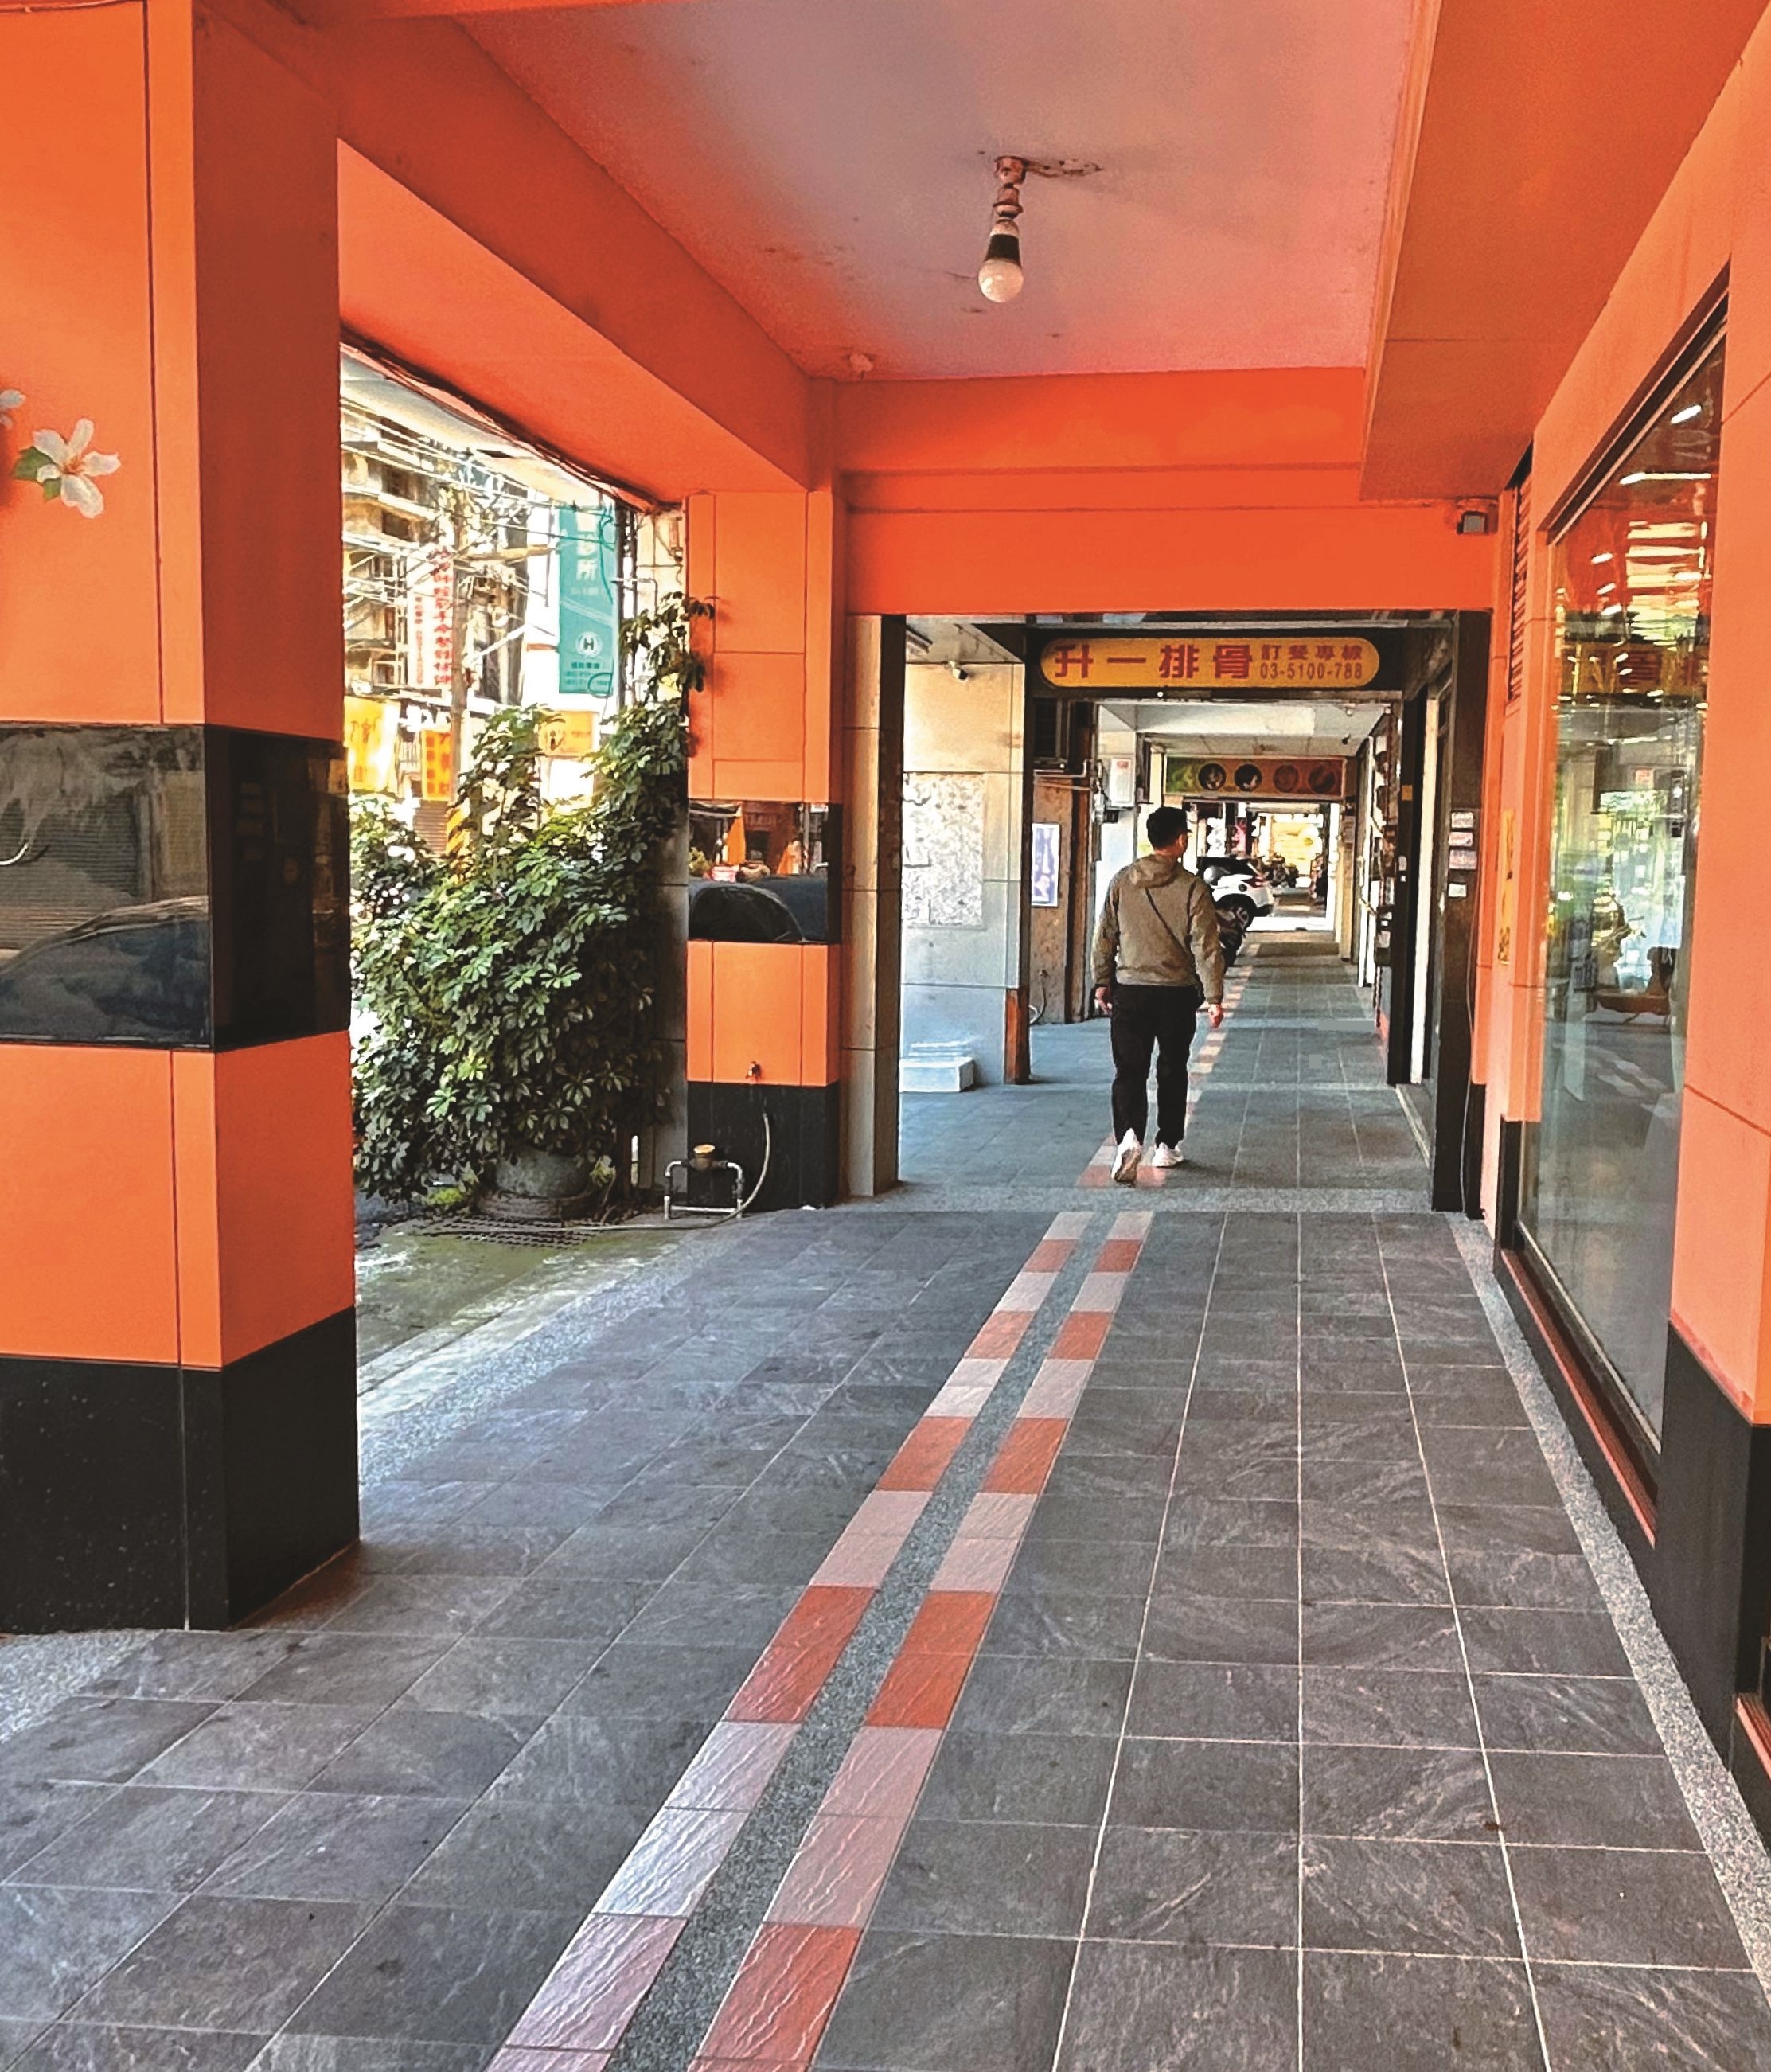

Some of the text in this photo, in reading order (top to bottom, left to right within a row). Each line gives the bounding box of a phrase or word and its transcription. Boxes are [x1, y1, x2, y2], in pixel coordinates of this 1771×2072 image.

[1055, 644, 1252, 679] 升一排骨
[1261, 662, 1362, 679] 03-5100-788
